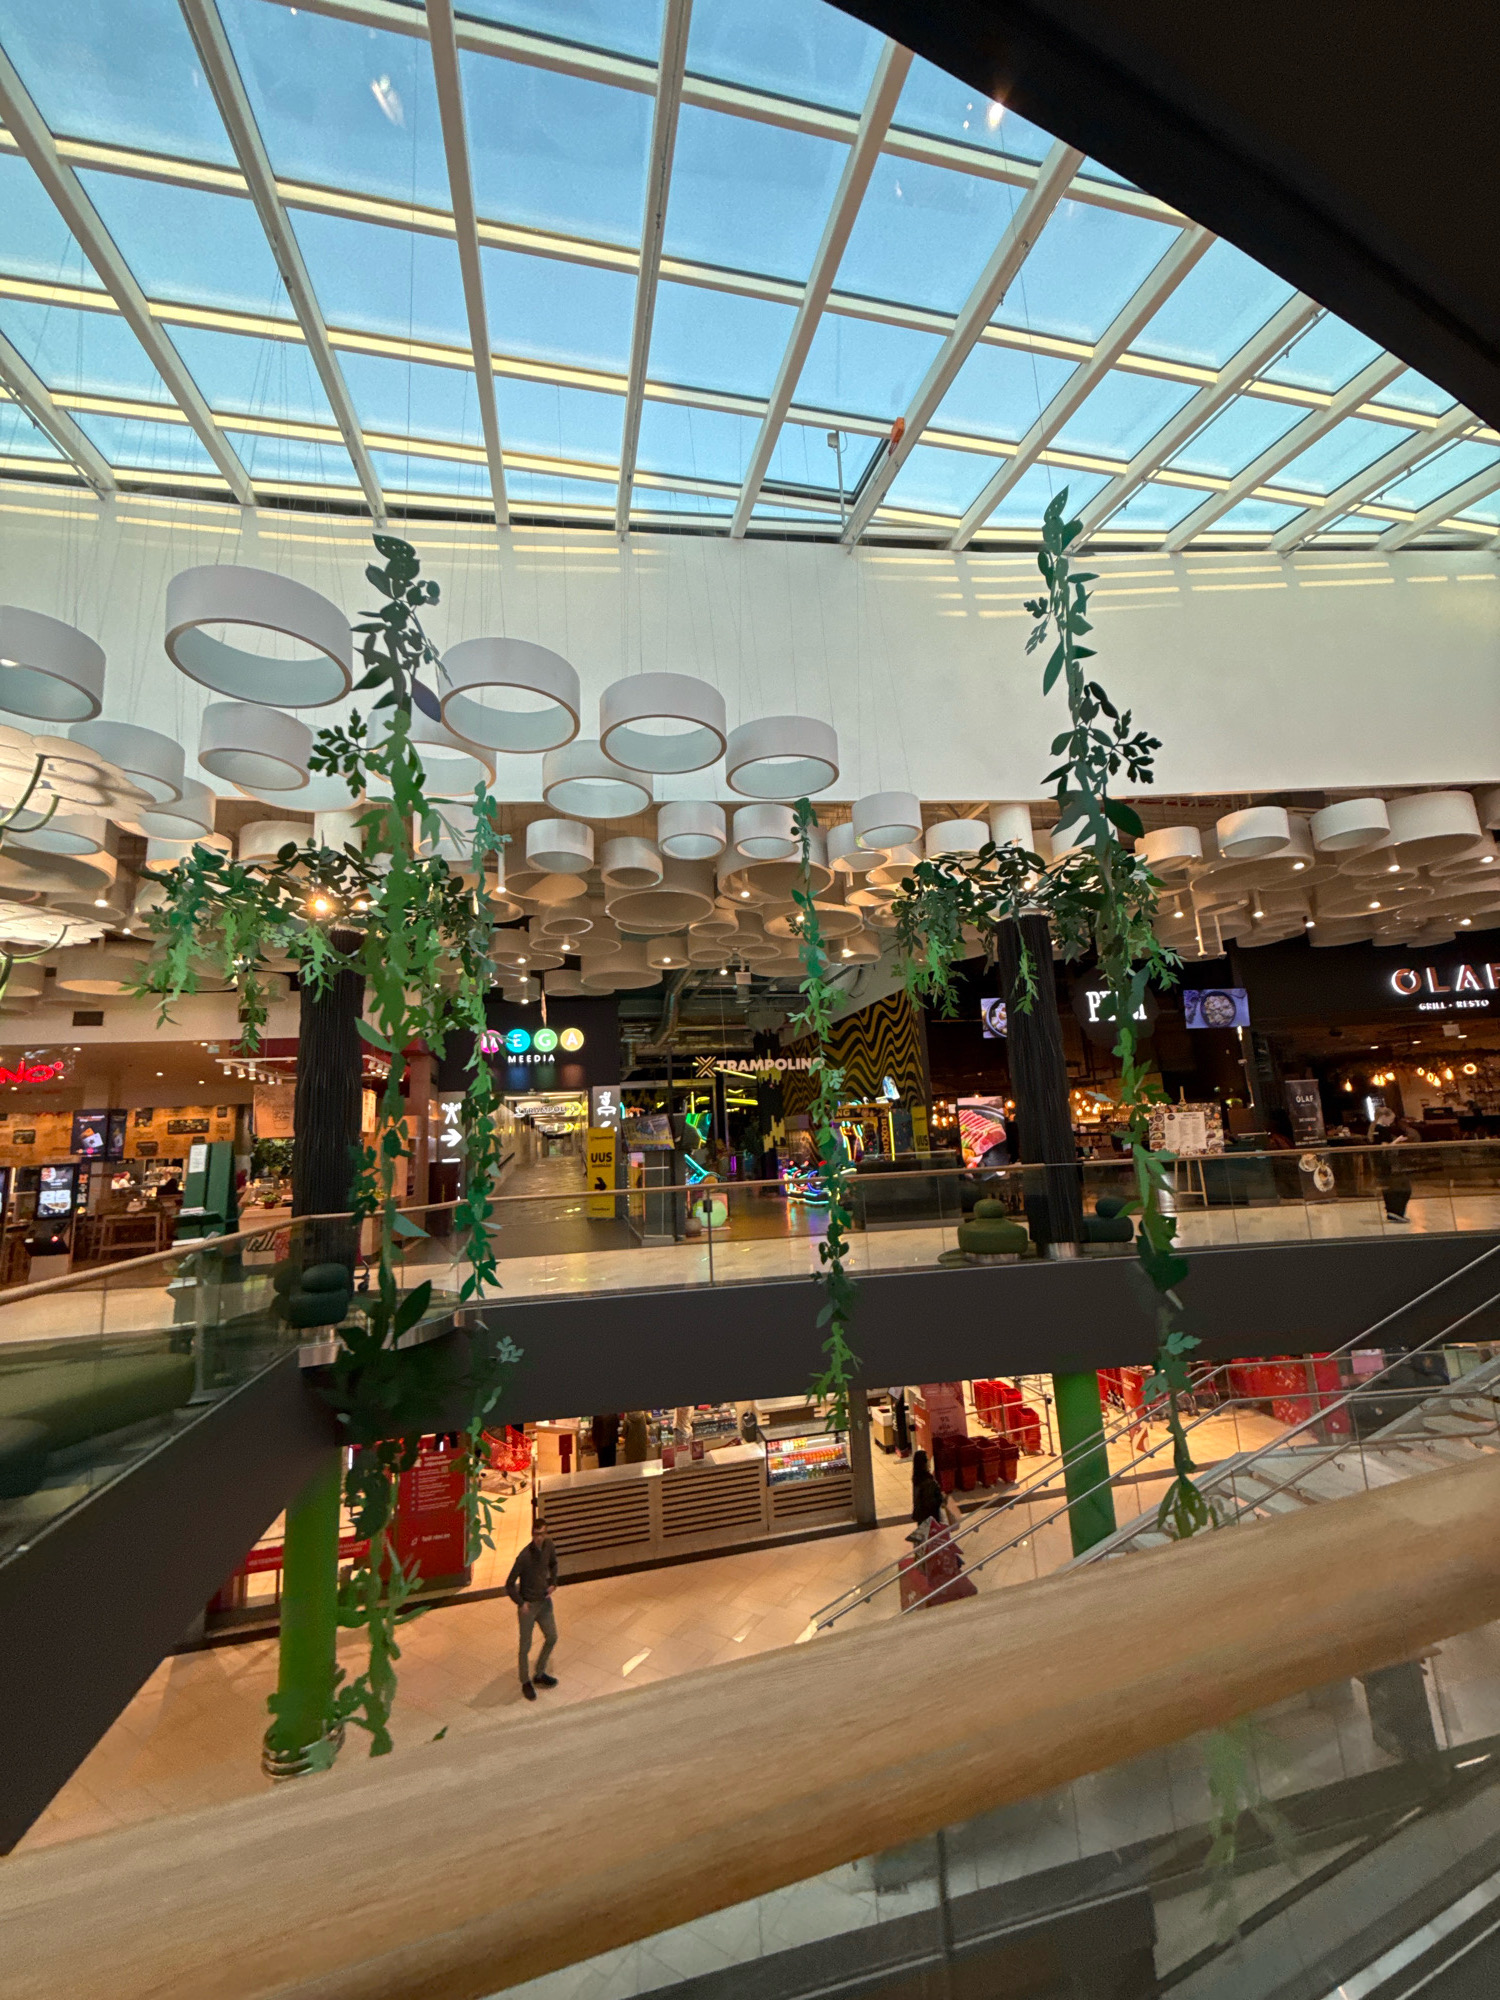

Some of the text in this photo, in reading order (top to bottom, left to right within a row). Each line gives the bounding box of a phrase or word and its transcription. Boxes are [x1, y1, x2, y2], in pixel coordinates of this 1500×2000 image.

[1418, 999, 1490, 1011] GRILL RESTO
[507, 1054, 555, 1064] MEEDIA
[1295, 1094, 1314, 1104] OLAF
[590, 1152, 613, 1163] UUS
